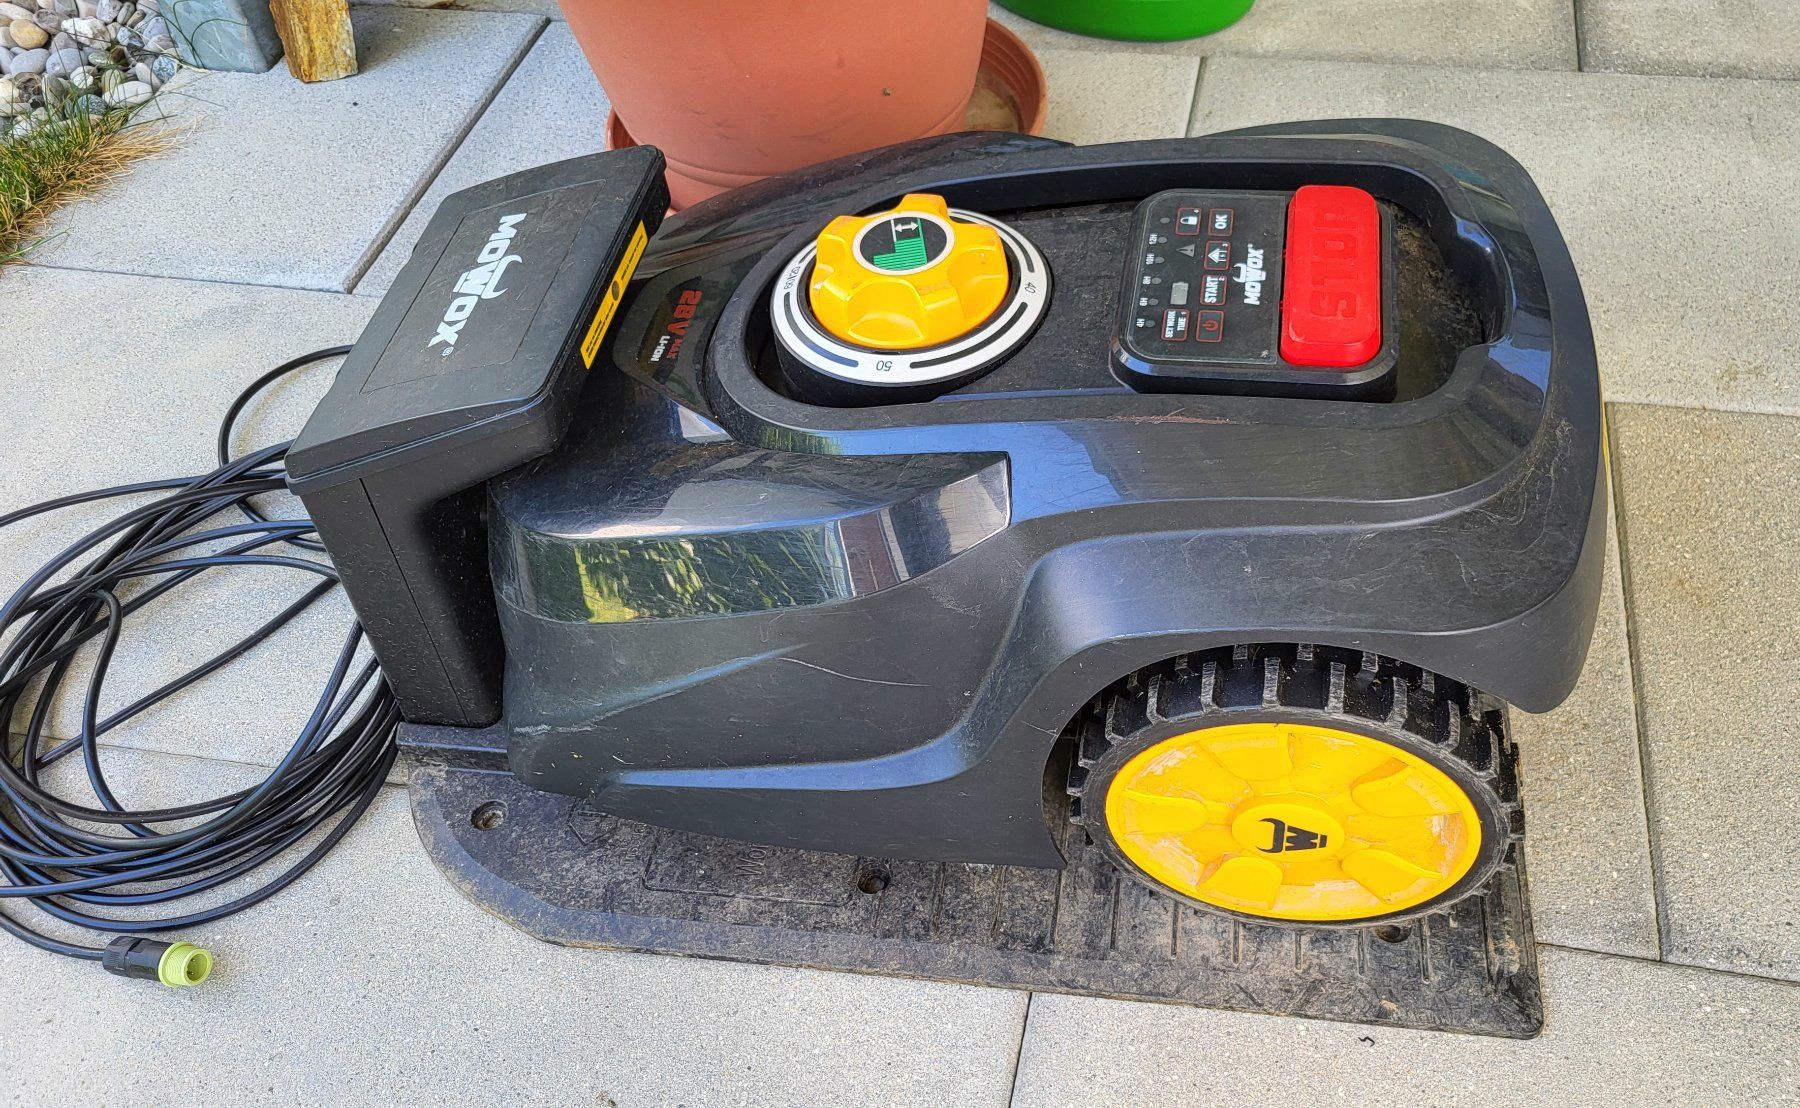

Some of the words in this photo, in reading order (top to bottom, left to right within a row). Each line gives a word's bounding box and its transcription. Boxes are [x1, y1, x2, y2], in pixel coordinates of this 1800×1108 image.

[1214, 214, 1228, 230] OK
[1149, 233, 1158, 245] 12H
[1310, 206, 1358, 319] STOP
[1025, 282, 1037, 294] 40
[1204, 275, 1219, 304] START
[667, 290, 703, 336] 28V
[1166, 310, 1176, 327] WORK
[1136, 318, 1146, 328] 4H
[1177, 316, 1187, 331] TIME
[1165, 326, 1174, 338] SET
[875, 360, 893, 372] 50
